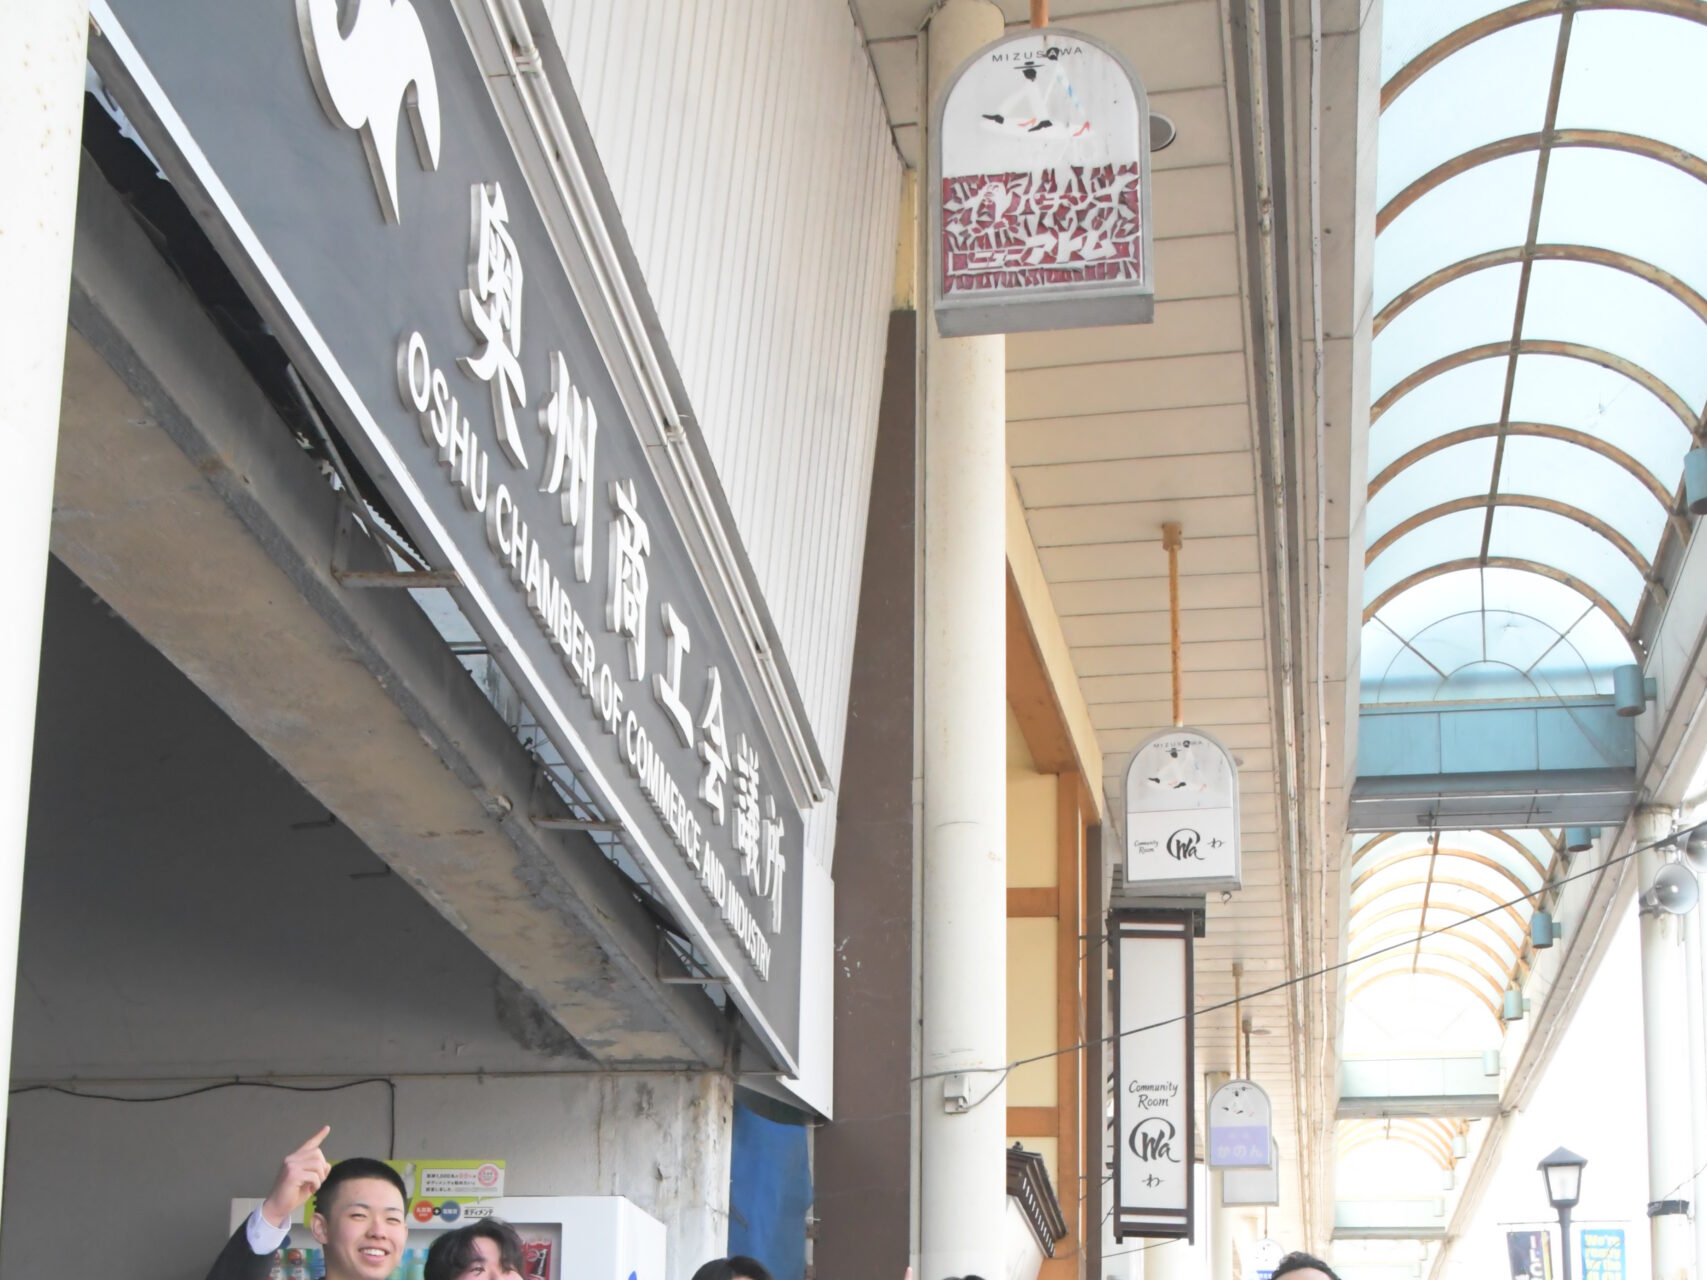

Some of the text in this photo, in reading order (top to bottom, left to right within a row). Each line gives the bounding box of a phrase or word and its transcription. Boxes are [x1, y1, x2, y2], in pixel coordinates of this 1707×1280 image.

[992, 46, 1083, 62] MIZUSAWA
[457, 181, 786, 934] 奥州商工会議所
[397, 331, 771, 981] OSHU CHAMBER OF COMMERCE AND INDUSTRY
[1129, 1080, 1179, 1097] Community
[1137, 1095, 1169, 1110] Room
[1142, 1173, 1165, 1188] わ
